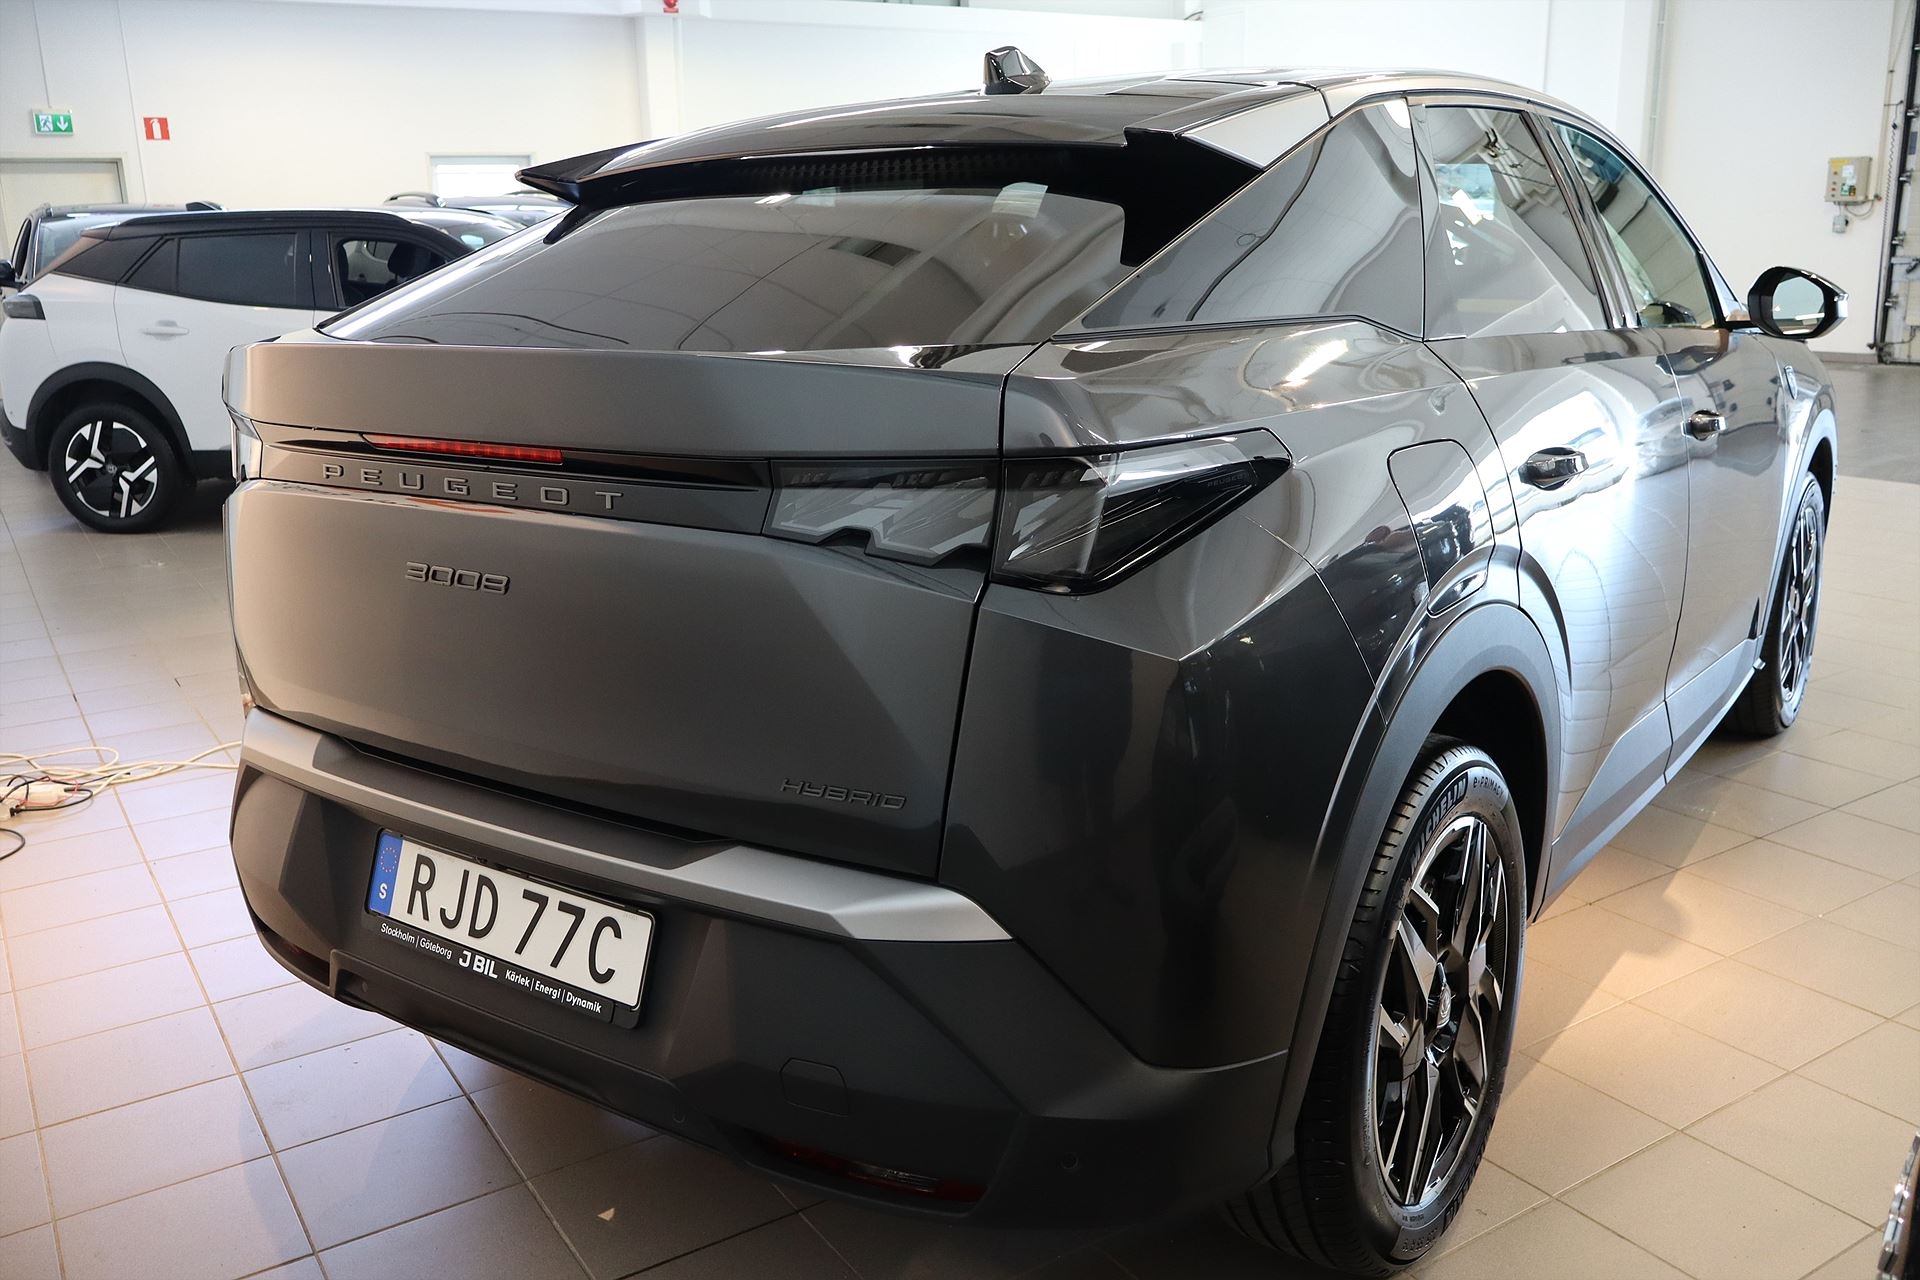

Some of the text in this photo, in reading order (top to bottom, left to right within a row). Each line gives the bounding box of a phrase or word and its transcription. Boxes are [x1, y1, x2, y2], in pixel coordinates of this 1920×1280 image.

[322, 463, 624, 510] PEUGEOT
[405, 560, 510, 595] 3008
[780, 778, 907, 809] HYBRID
[1411, 777, 1467, 875] MICHELIN
[378, 882, 388, 900] S
[407, 853, 622, 984] RJD 77C
[380, 922, 415, 944] Stockholm
[420, 937, 452, 960] Göteborg
[472, 954, 498, 979] BIL
[505, 969, 530, 987] Kärlek
[535, 980, 561, 999] Energi
[566, 991, 602, 1014] Dynamik
